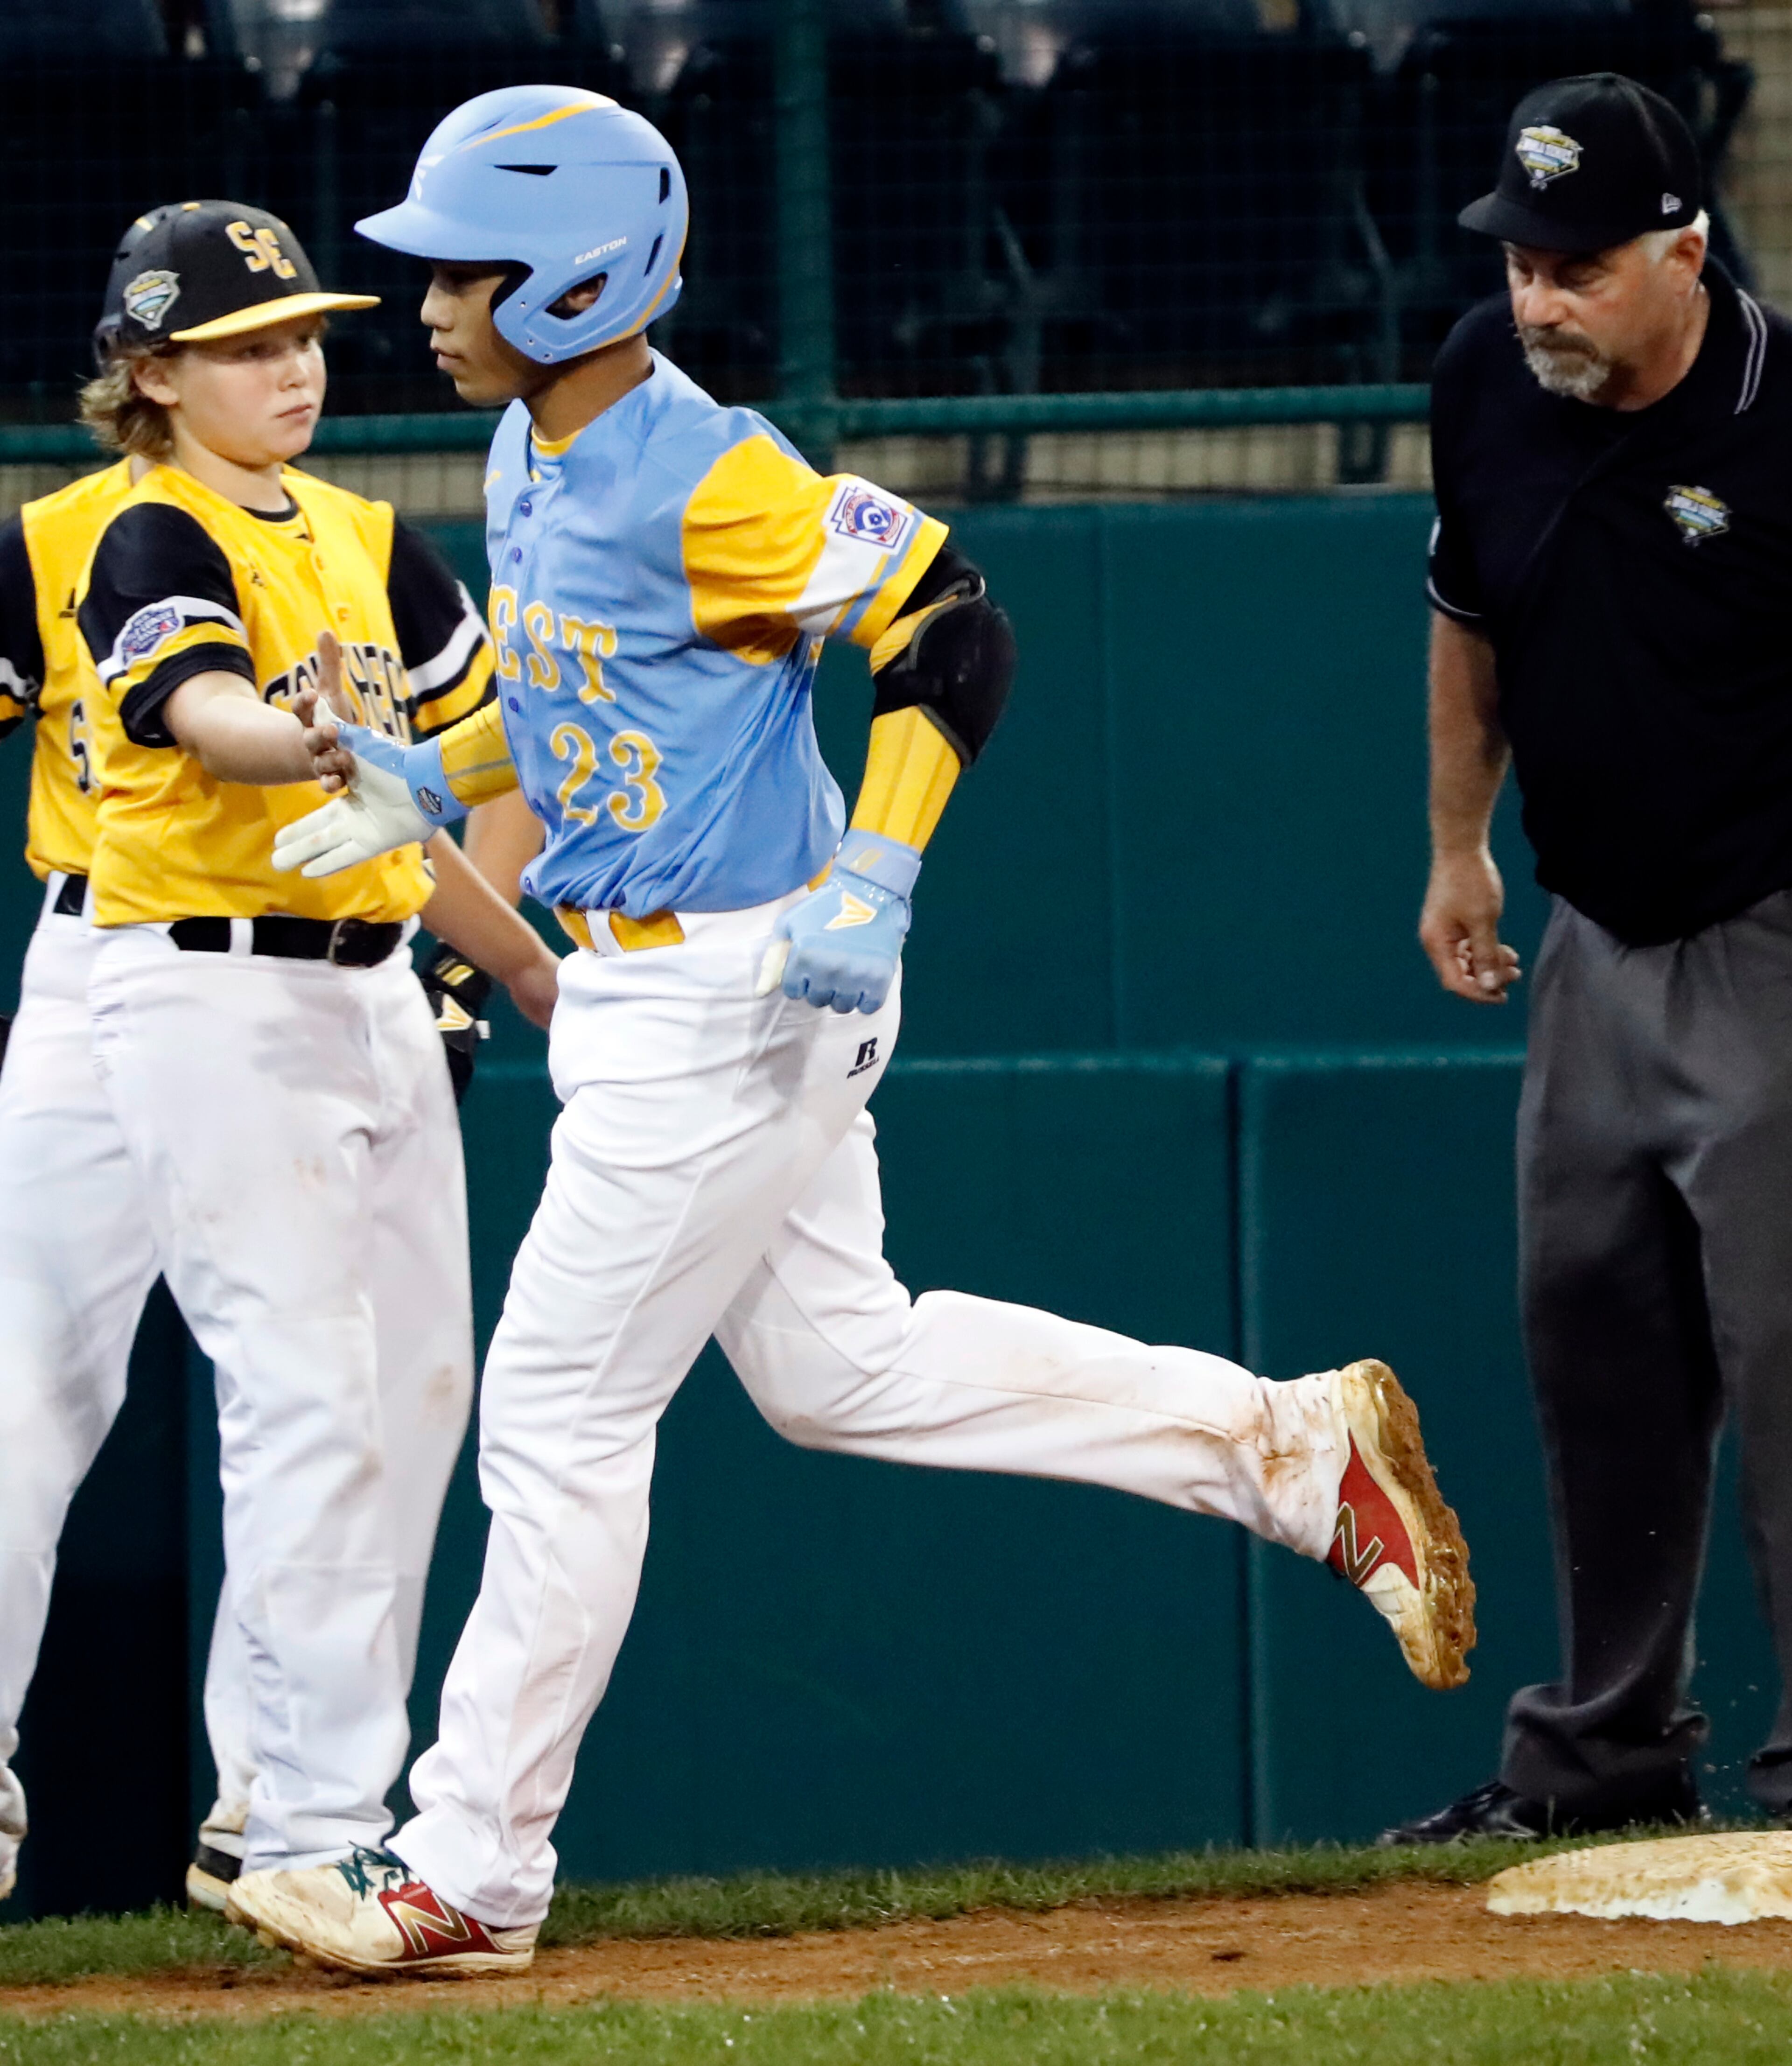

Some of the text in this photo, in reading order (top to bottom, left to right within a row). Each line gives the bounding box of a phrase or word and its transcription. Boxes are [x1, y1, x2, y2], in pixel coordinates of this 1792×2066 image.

[225, 221, 297, 280] SE
[574, 235, 627, 265] EASTON
[549, 721, 668, 833] 23
[855, 1036, 878, 1068] R
